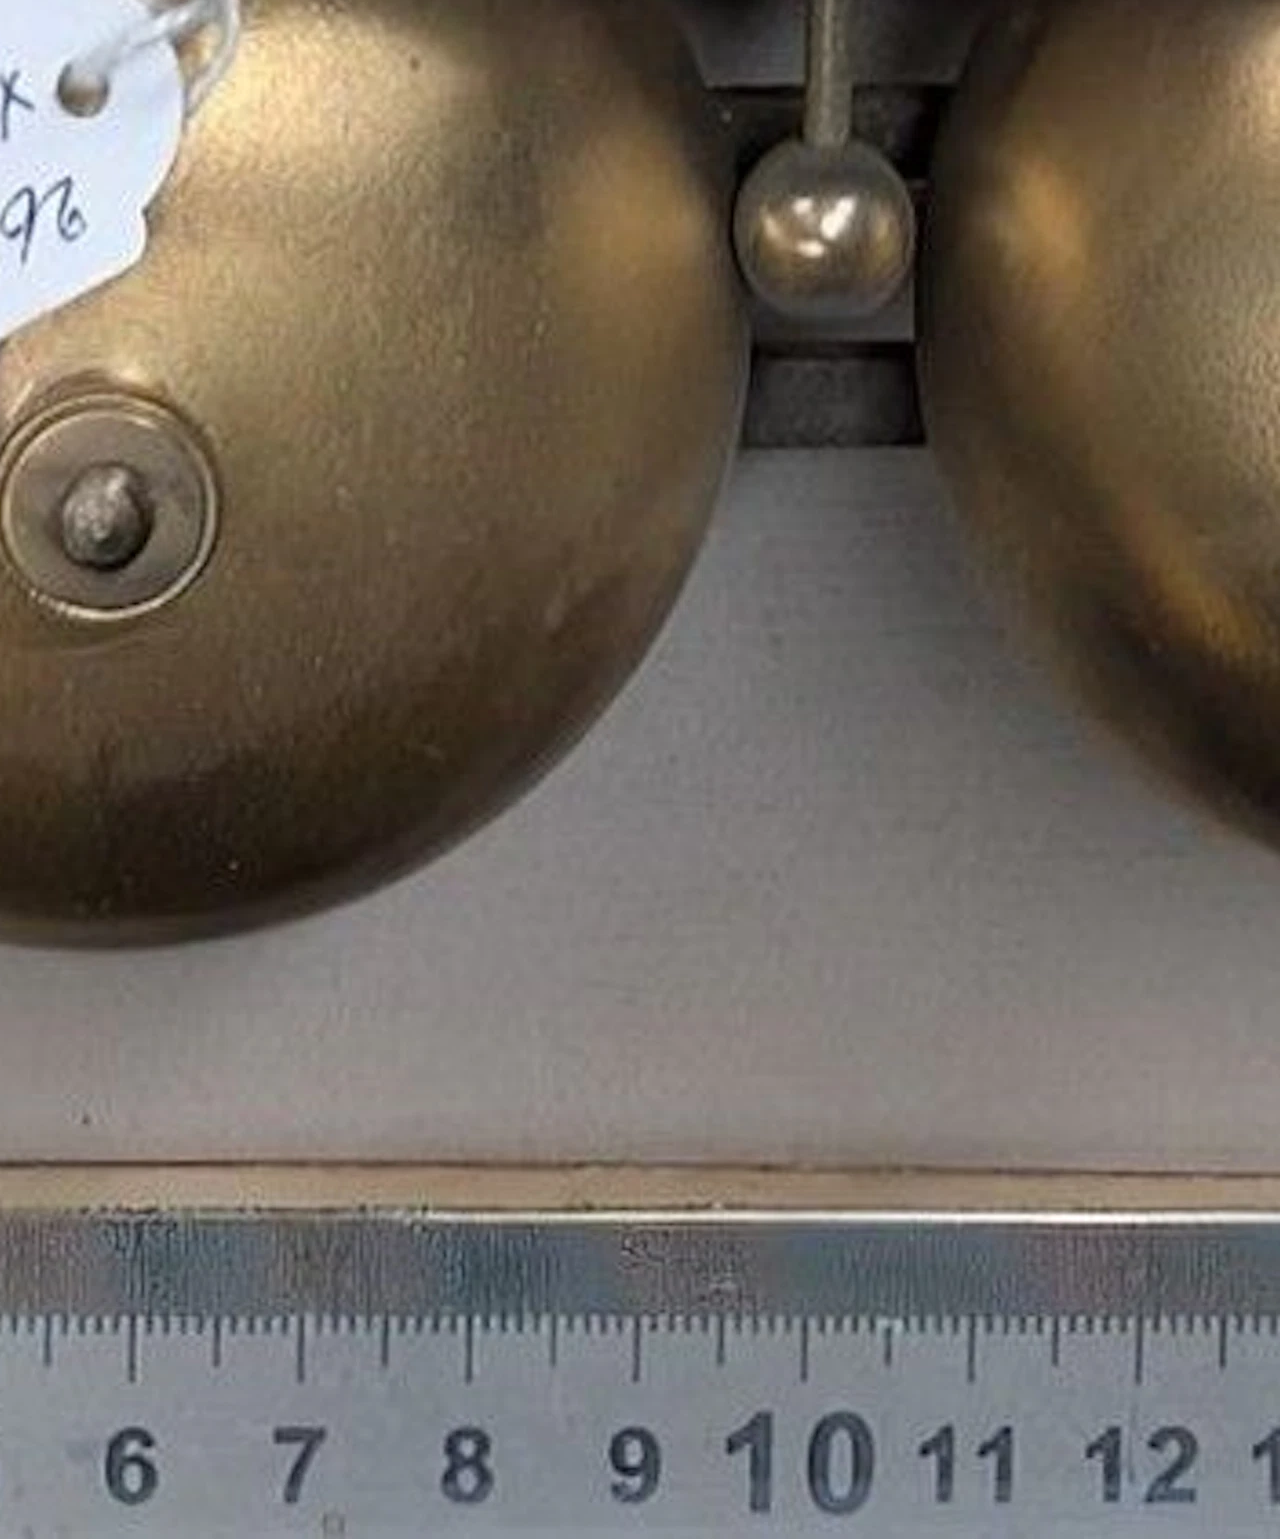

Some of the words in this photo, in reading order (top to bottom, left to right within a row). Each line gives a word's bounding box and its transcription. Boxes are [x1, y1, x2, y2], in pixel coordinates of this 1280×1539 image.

[105, 1428, 158, 1505] 6
[273, 1428, 325, 1504] 7
[441, 1428, 493, 1503] 8
[609, 1428, 661, 1503] 9
[725, 1413, 874, 1514] 10
[919, 1425, 1014, 1503] 11
[1086, 1427, 1198, 1503] 12
